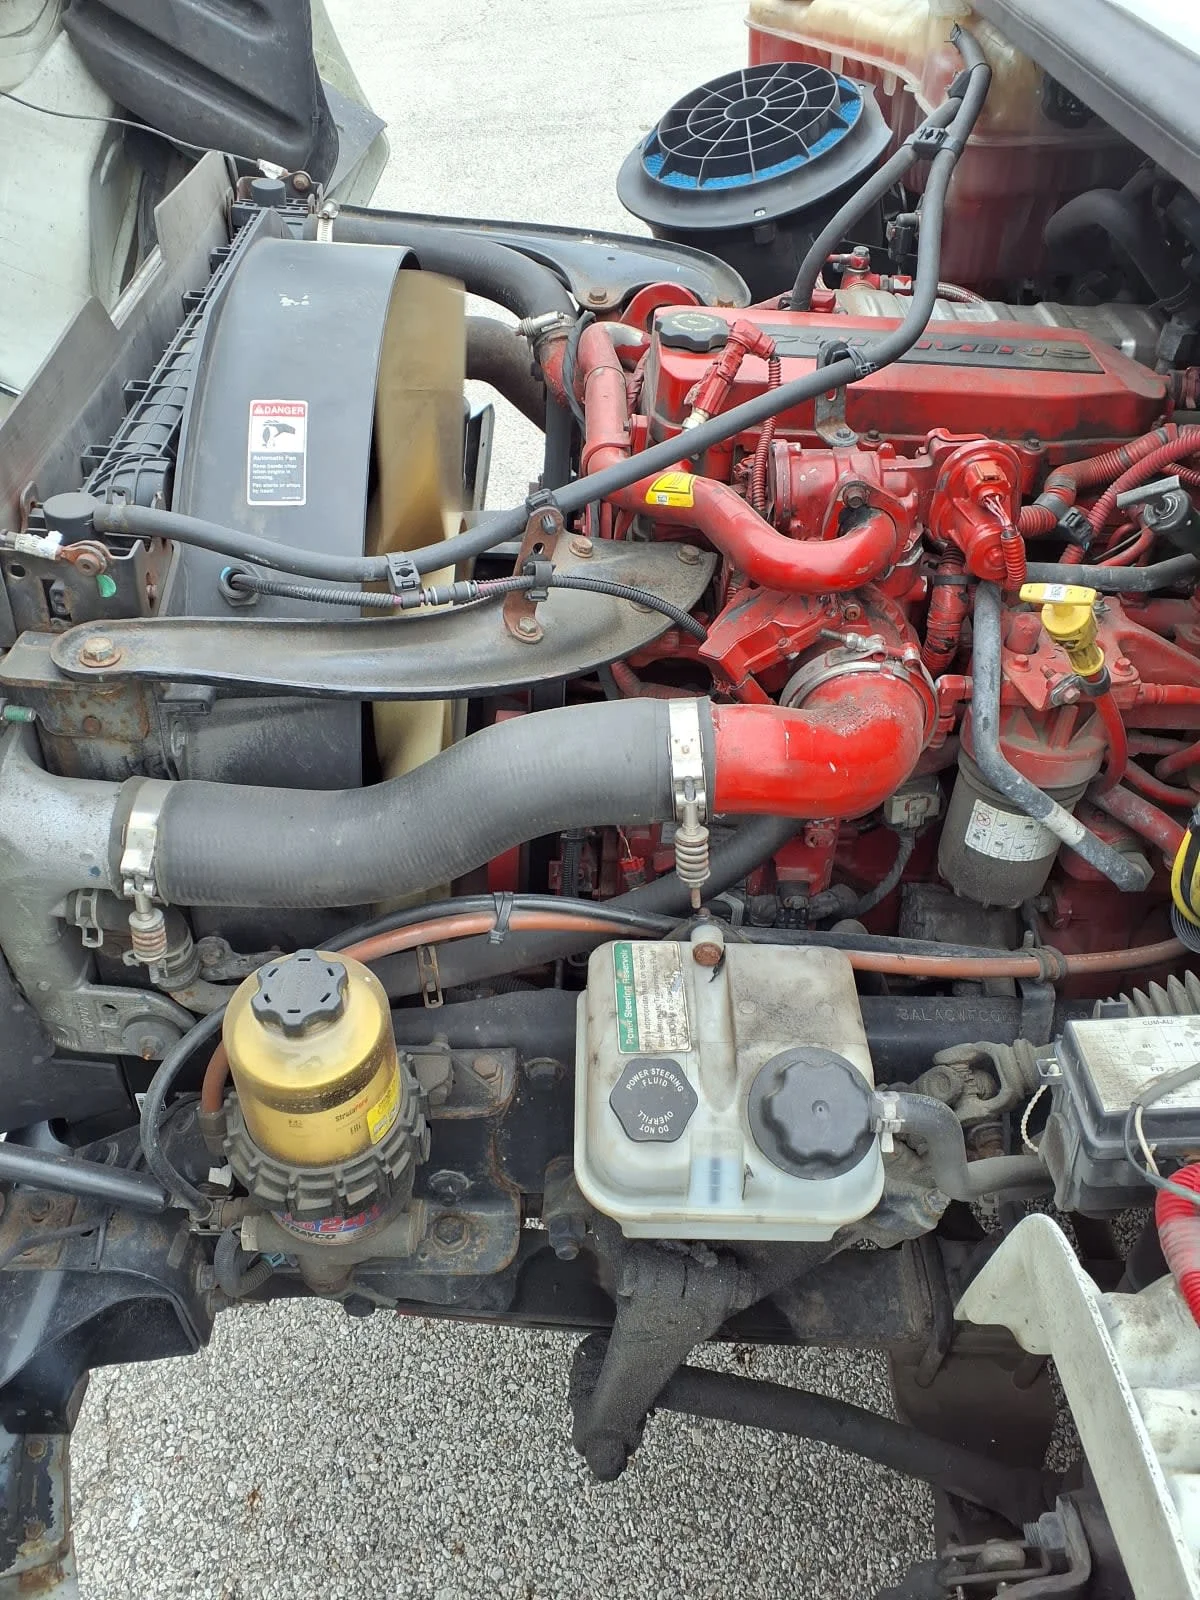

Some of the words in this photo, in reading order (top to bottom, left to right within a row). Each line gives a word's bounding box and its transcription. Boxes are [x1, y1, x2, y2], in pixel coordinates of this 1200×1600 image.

[768, 333, 1091, 359] CUMINS
[264, 405, 304, 415] DANGER
[623, 985, 634, 1018] Steering
[626, 1019, 634, 1044] Power
[626, 1069, 650, 1091] POWER
[651, 1068, 684, 1092] STEERING
[642, 1077, 668, 1087] FLUID
[638, 1110, 674, 1126] OVERFILL
[640, 1124, 655, 1134] NOT
[658, 1124, 670, 1134] DO
